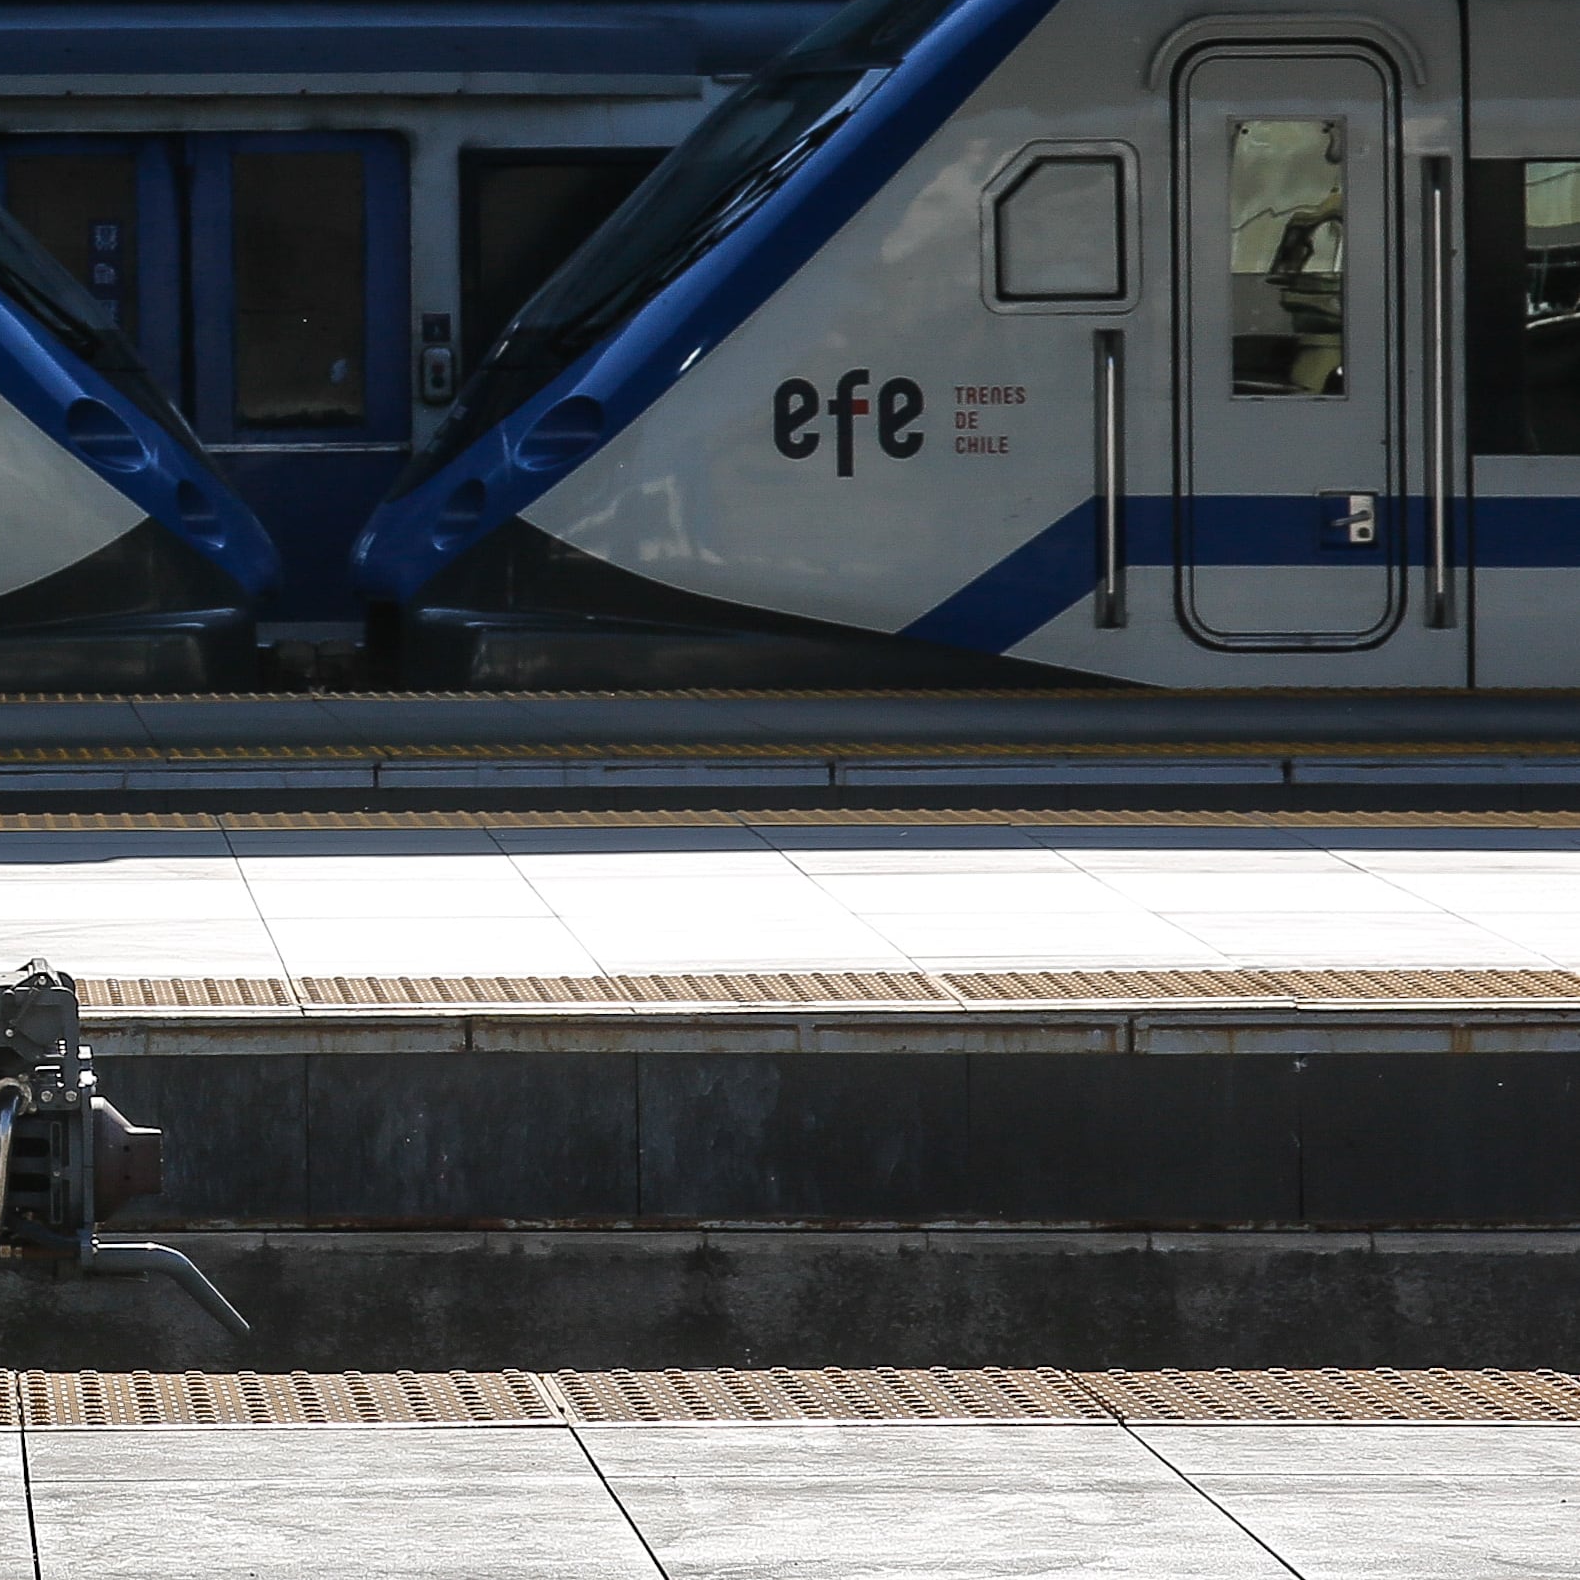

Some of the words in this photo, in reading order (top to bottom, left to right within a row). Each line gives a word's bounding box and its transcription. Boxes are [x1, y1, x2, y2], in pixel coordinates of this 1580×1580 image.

[772, 368, 925, 479] efe
[954, 410, 979, 431] DE
[954, 435, 1010, 456] CHILE
